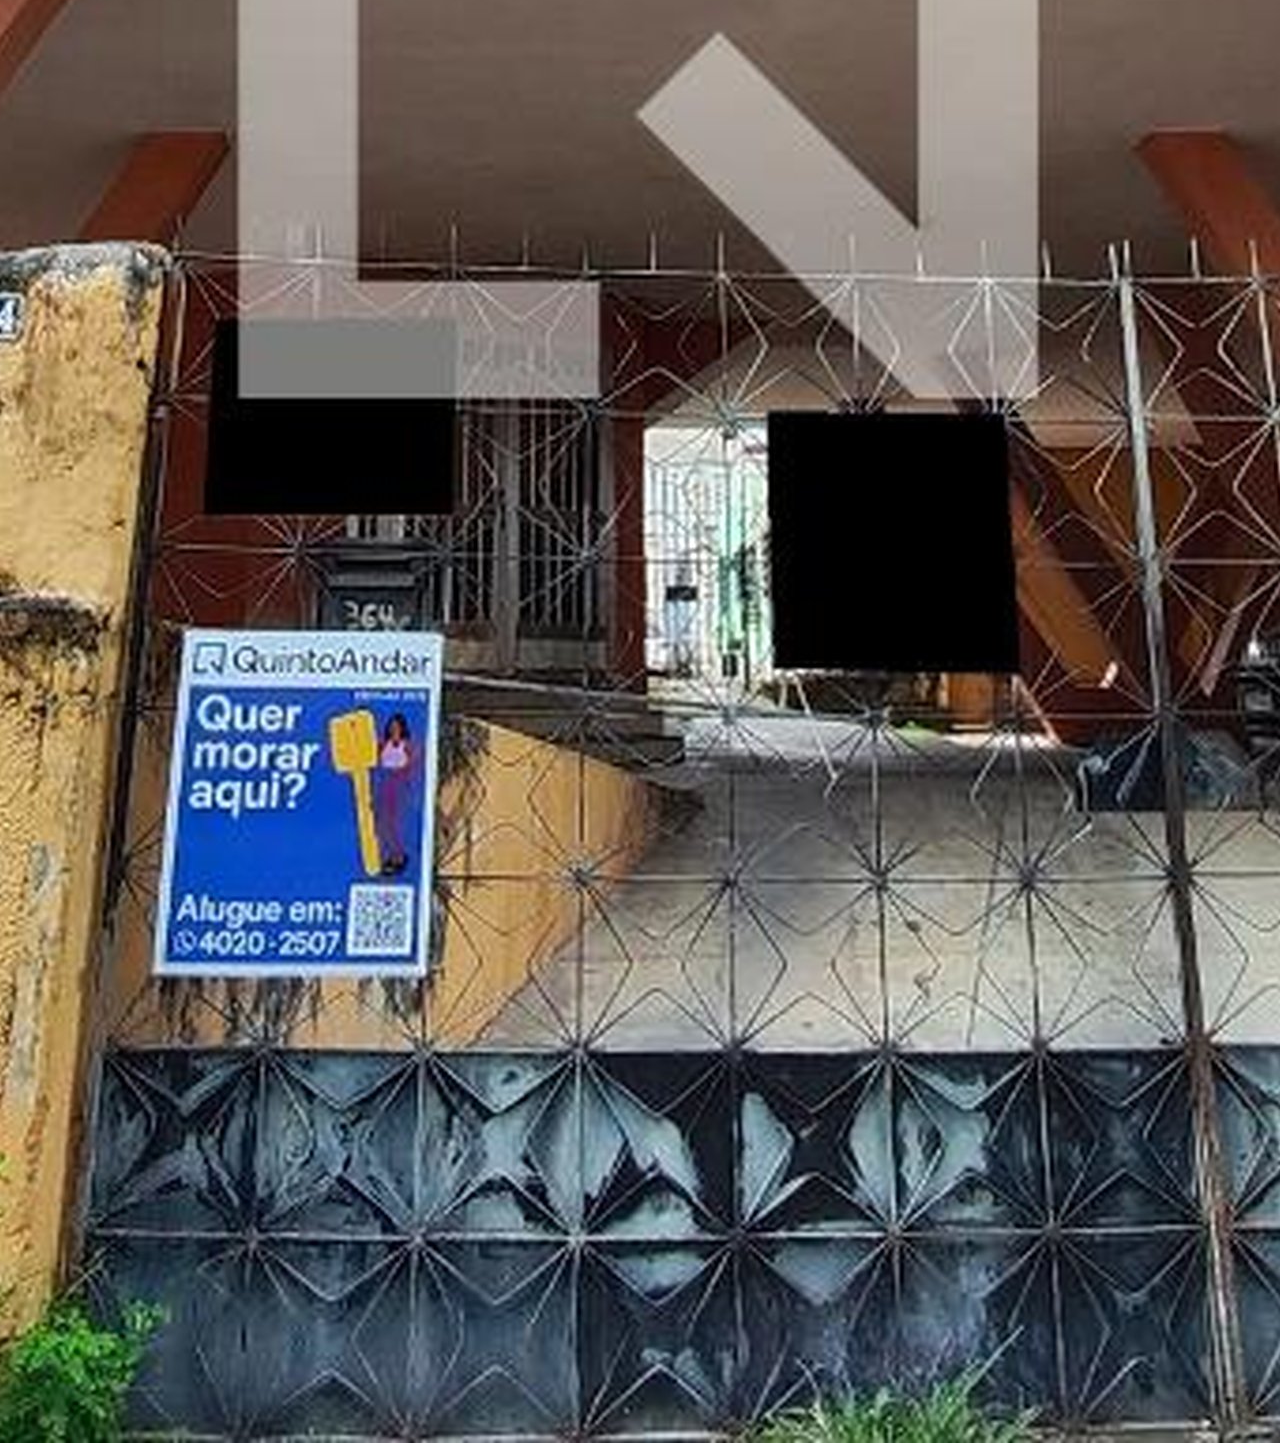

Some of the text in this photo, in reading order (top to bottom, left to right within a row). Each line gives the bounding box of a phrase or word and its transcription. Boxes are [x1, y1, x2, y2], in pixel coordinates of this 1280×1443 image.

[233, 645, 431, 674] QuintoAndar
[197, 694, 302, 732] Quer
[192, 741, 319, 770] morar
[188, 772, 307, 819] aqui?
[176, 894, 343, 929] Alugue em:
